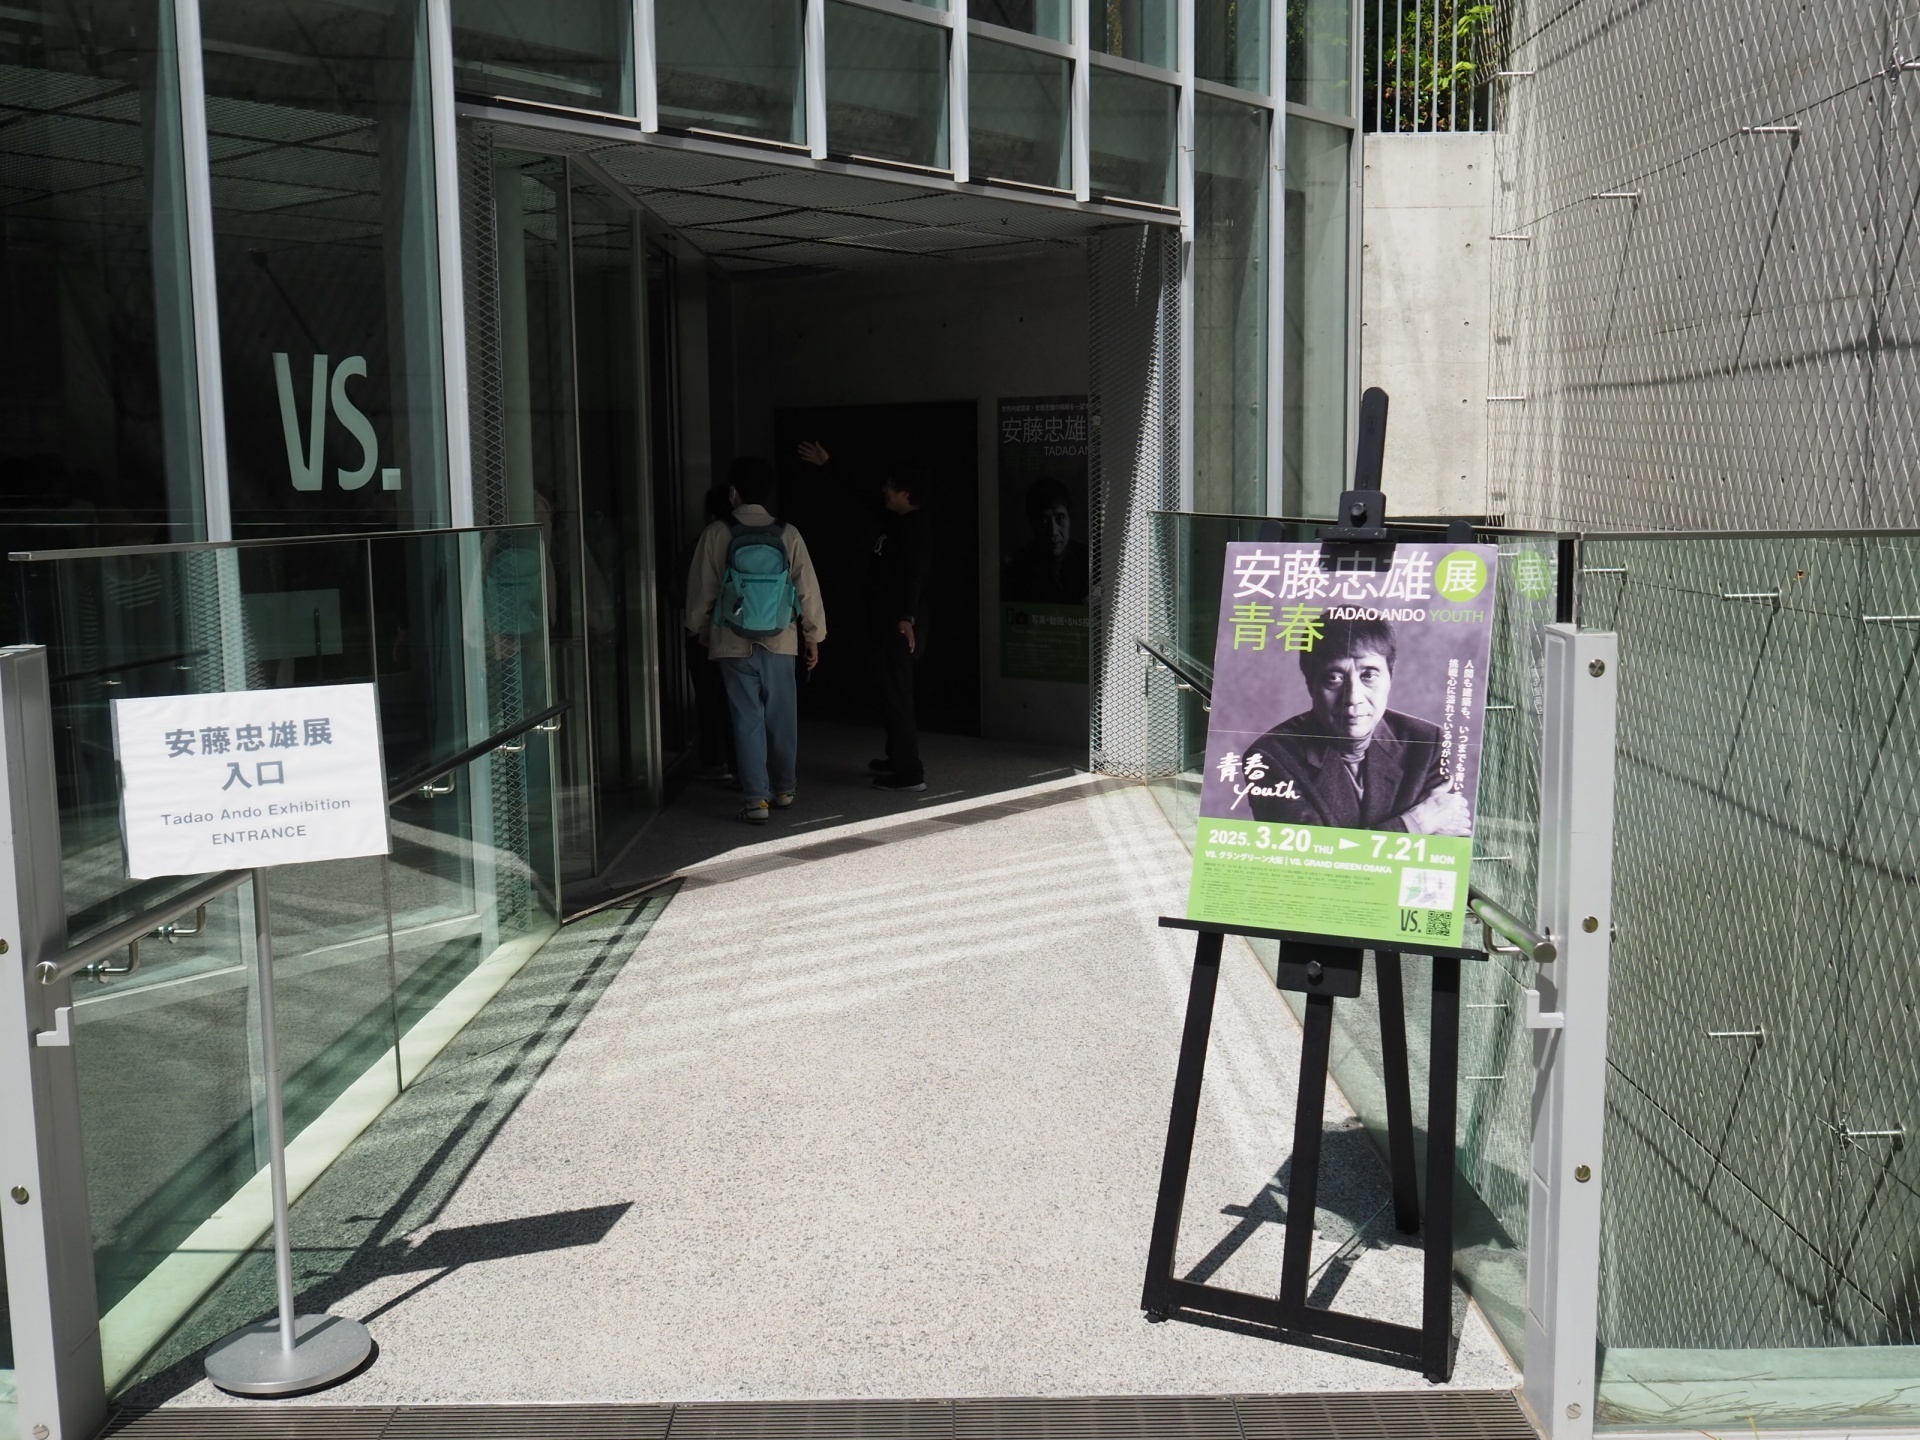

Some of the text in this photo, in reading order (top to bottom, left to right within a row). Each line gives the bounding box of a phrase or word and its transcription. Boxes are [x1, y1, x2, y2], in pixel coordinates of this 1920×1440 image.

[272, 352, 402, 492] VS.
[1043, 446, 1076, 456] TADAO
[1229, 601, 1325, 653] 青春
[1328, 605, 1485, 624] TADAO ANDO YOUTH
[165, 717, 333, 758] 安藤忠雄展
[221, 761, 285, 791] 入口
[1216, 752, 1270, 783] 青春
[160, 798, 351, 826] Tadao Ando Exhibition
[212, 825, 307, 845] ENTRANCE
[1208, 826, 1455, 865] 2025. 3.20 THU 7.21 MON
[1204, 850, 1393, 874] VS. グラングリーン大阪 VS. GRAND GREEN OSAKA
[1401, 908, 1421, 933] VS.
